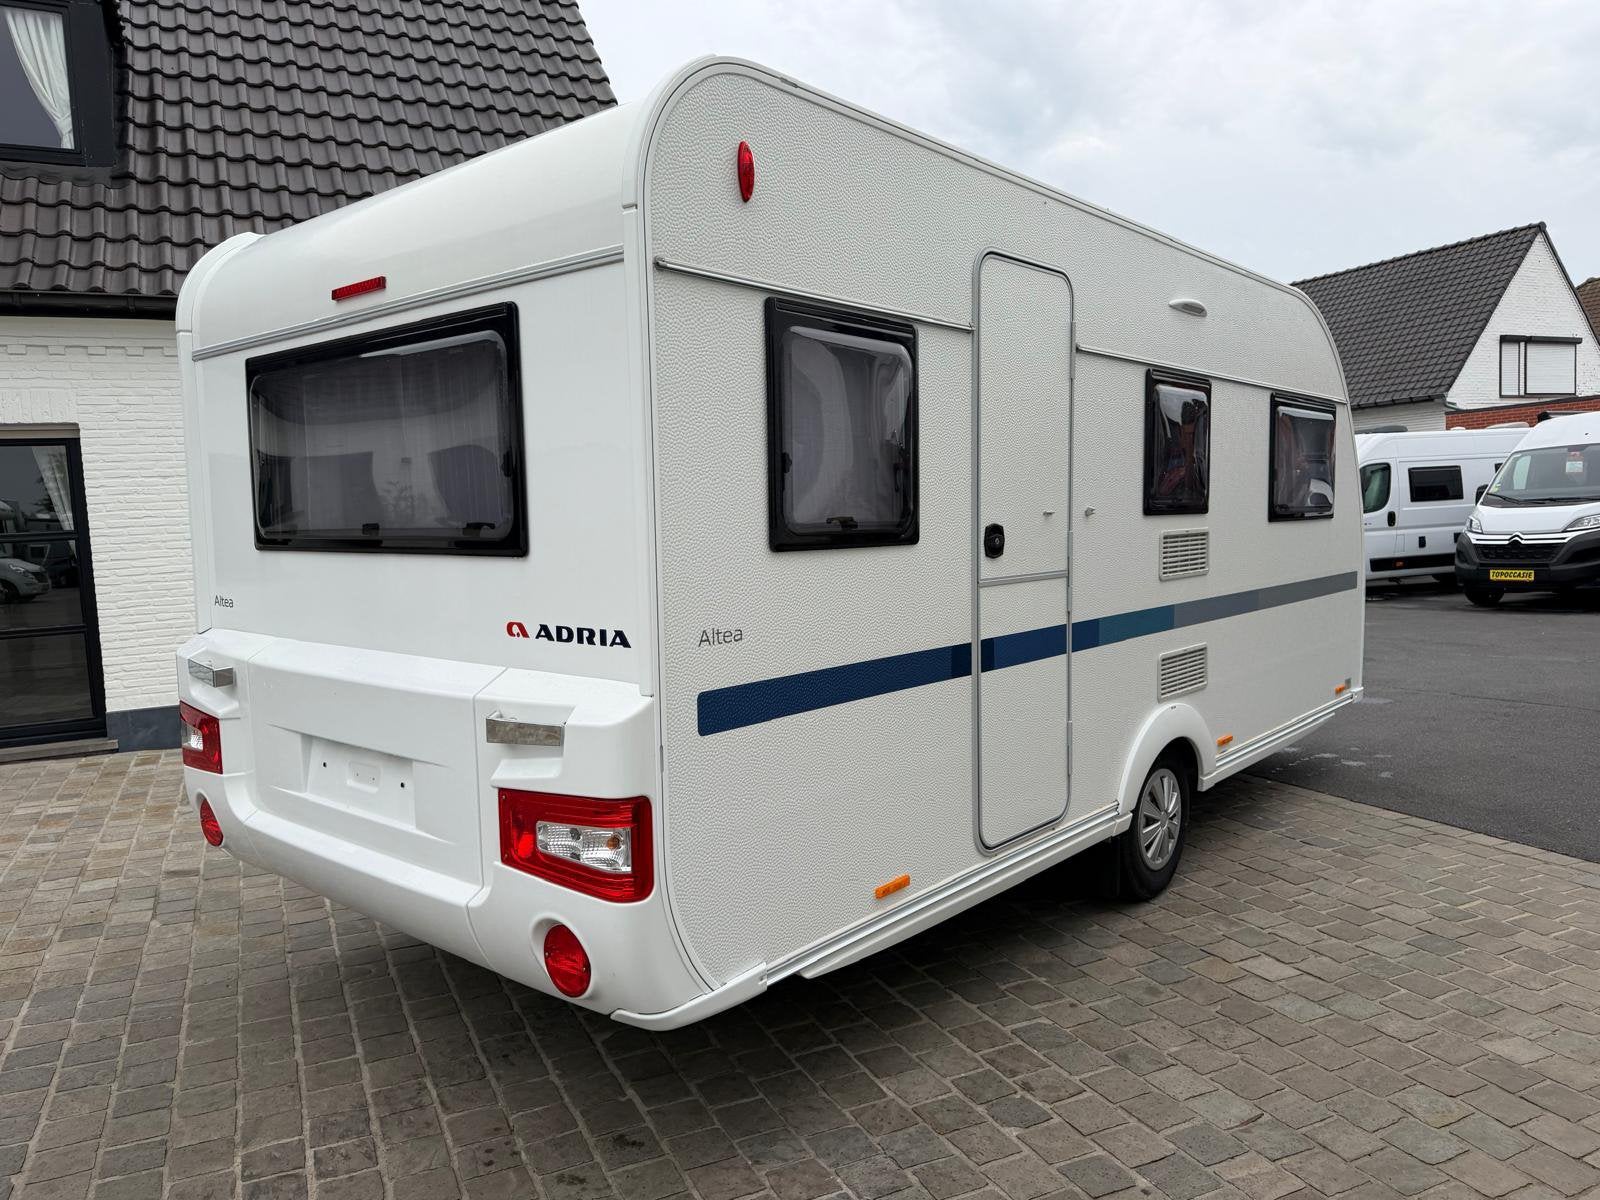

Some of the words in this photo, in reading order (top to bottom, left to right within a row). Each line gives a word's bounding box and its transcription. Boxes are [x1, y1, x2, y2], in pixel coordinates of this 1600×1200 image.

[1491, 571, 1533, 579] TOPOCCASIE
[214, 594, 234, 608] Altea
[535, 623, 632, 648] ADRIA
[698, 628, 744, 647] Altea
